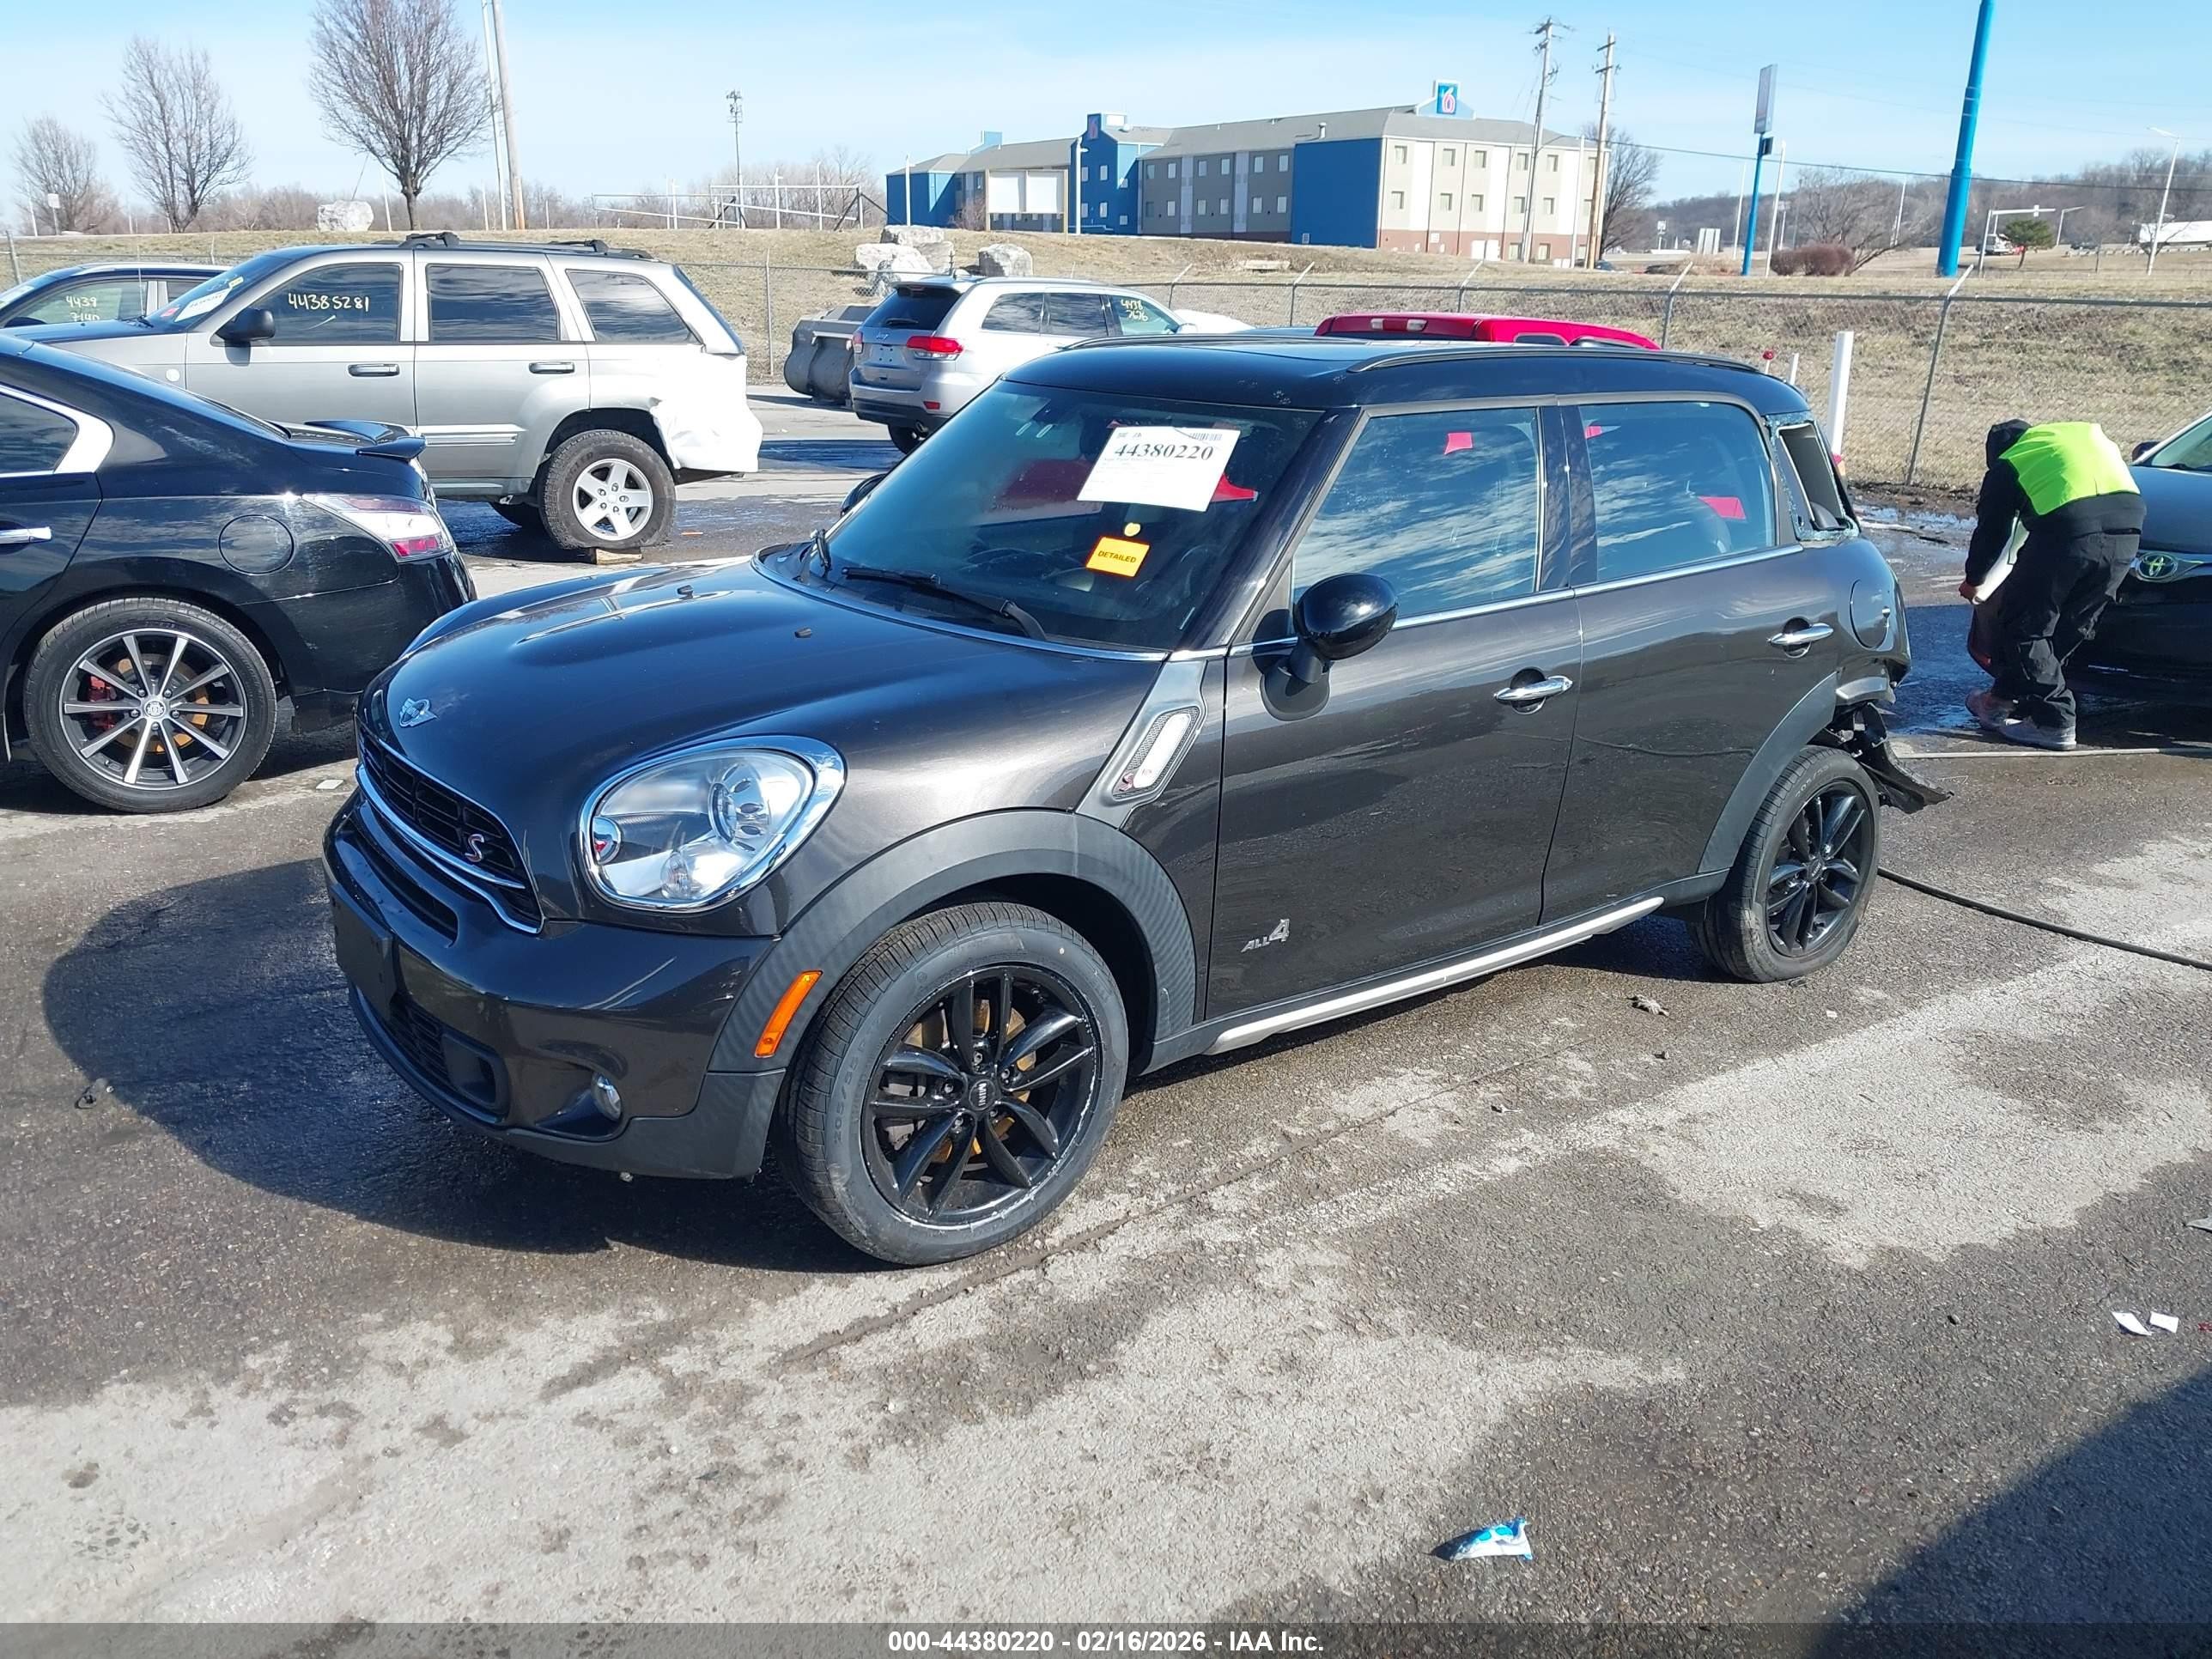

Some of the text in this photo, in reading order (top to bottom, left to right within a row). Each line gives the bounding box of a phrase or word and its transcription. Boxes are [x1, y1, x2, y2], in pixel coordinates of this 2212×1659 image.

[1441, 86, 1456, 113] 6
[66, 295, 97, 307] 4439
[289, 293, 369, 312] 44385281
[1115, 442, 1214, 461] 44380220
[1097, 550, 1137, 563] DETAILED
[465, 833, 485, 863] S
[978, 1082, 988, 1107] MINI
